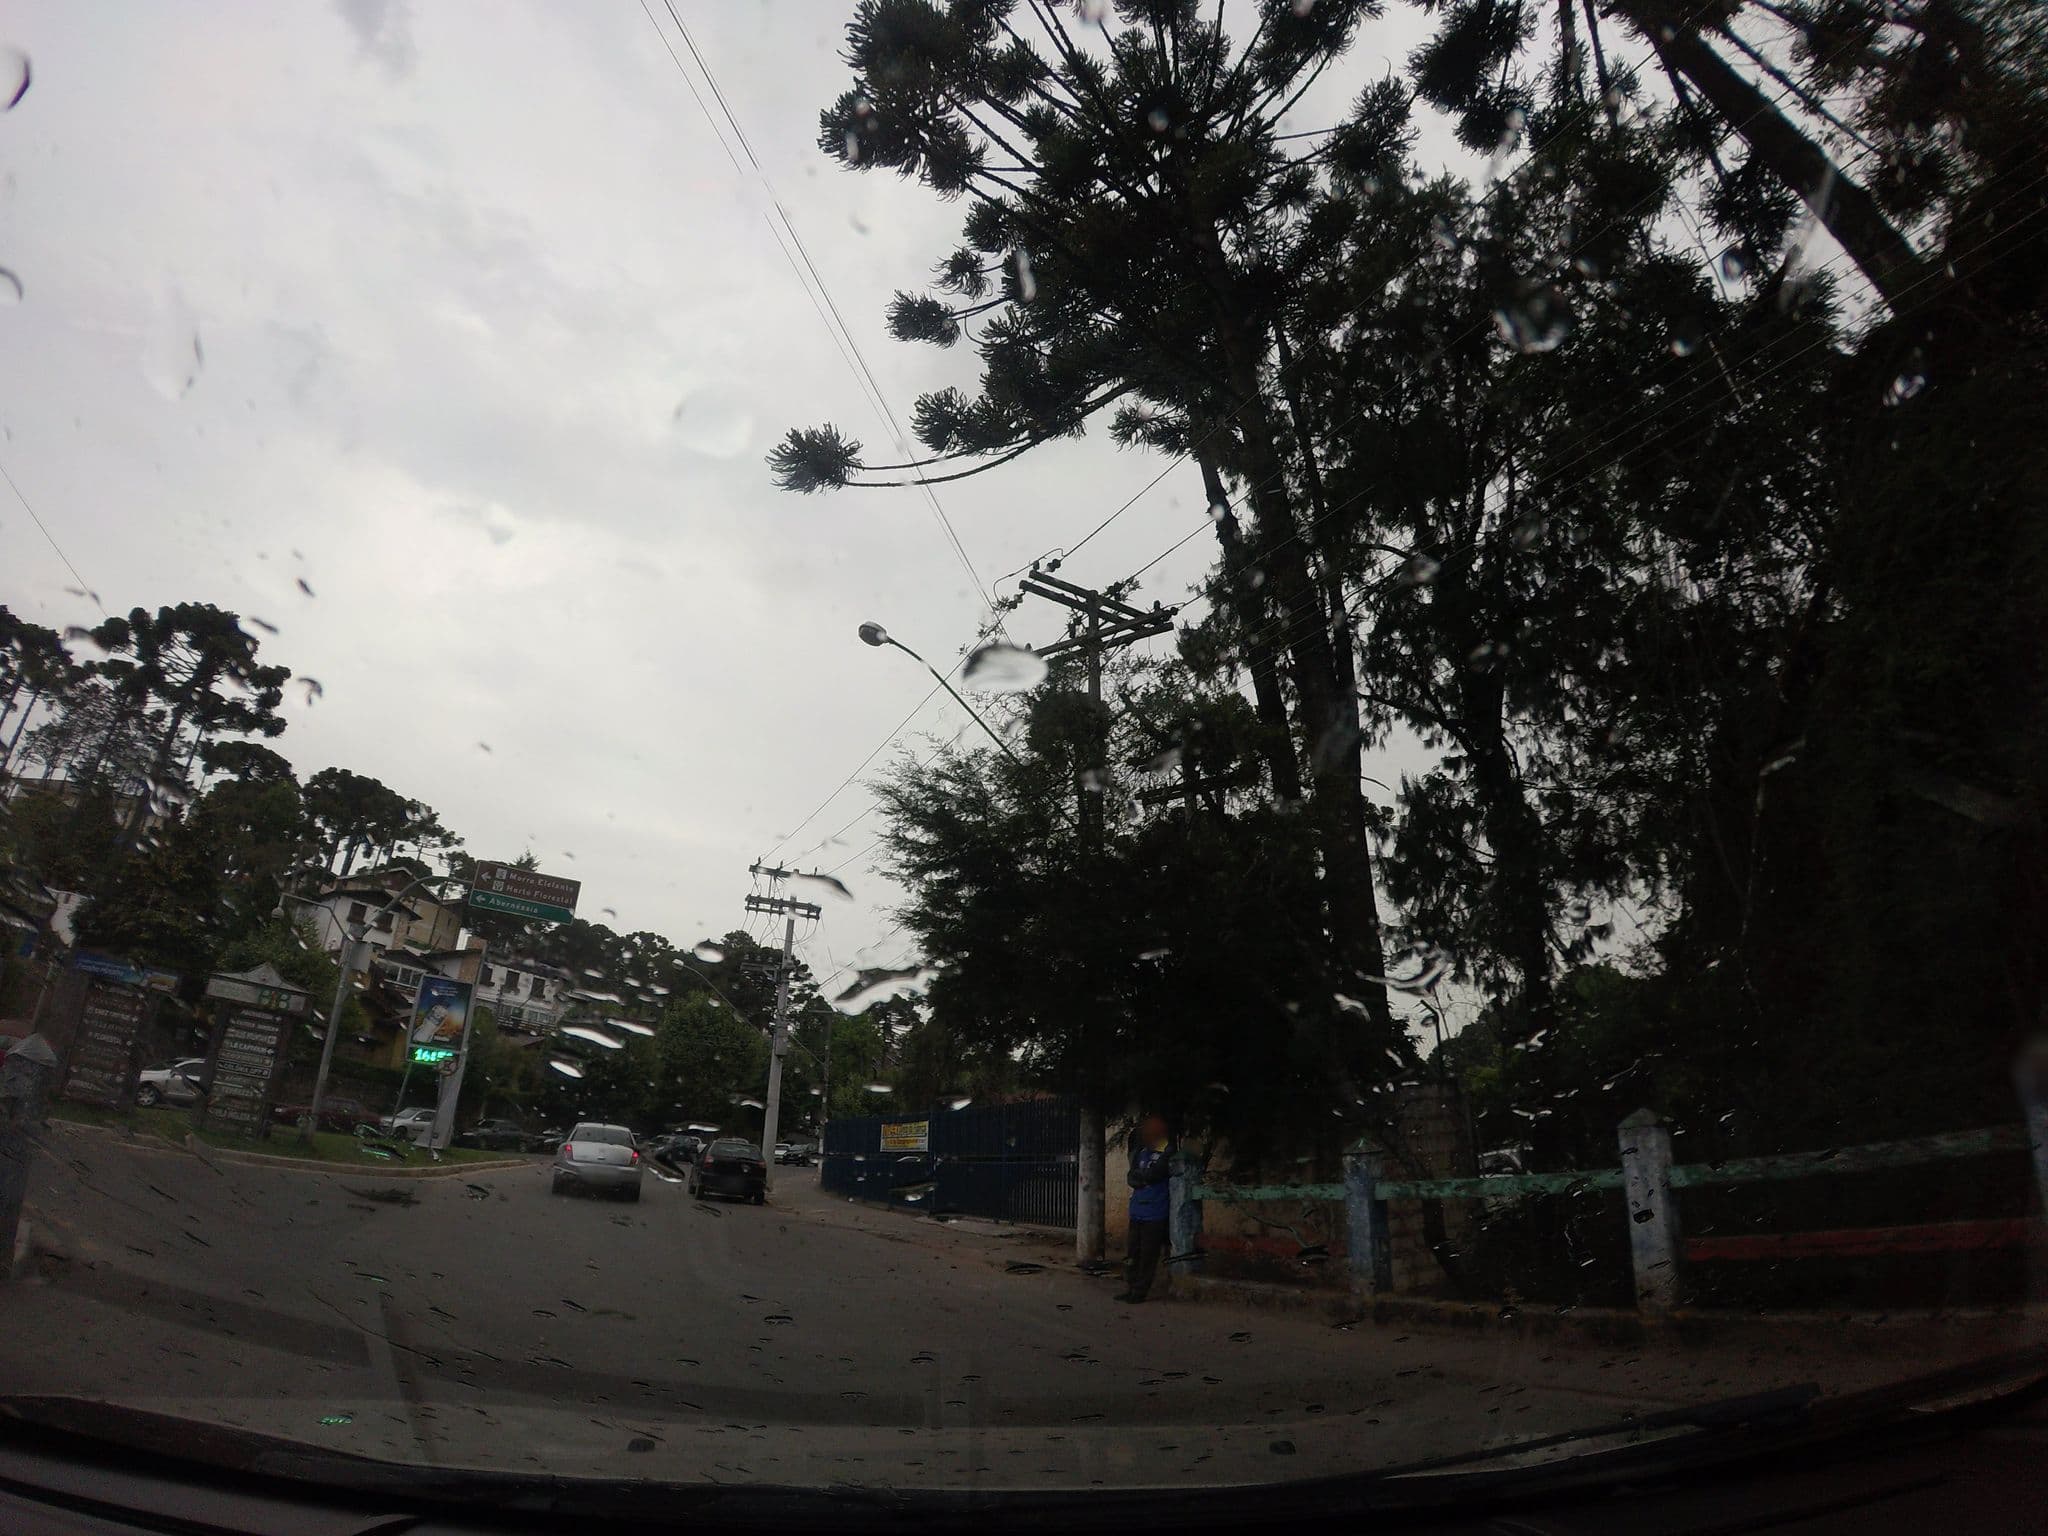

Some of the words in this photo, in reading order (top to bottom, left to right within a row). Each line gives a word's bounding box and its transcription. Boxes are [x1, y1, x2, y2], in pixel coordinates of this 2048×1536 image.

[537, 878, 574, 892] Elefante
[506, 884, 532, 896] Horto
[534, 890, 573, 905] Florestal
